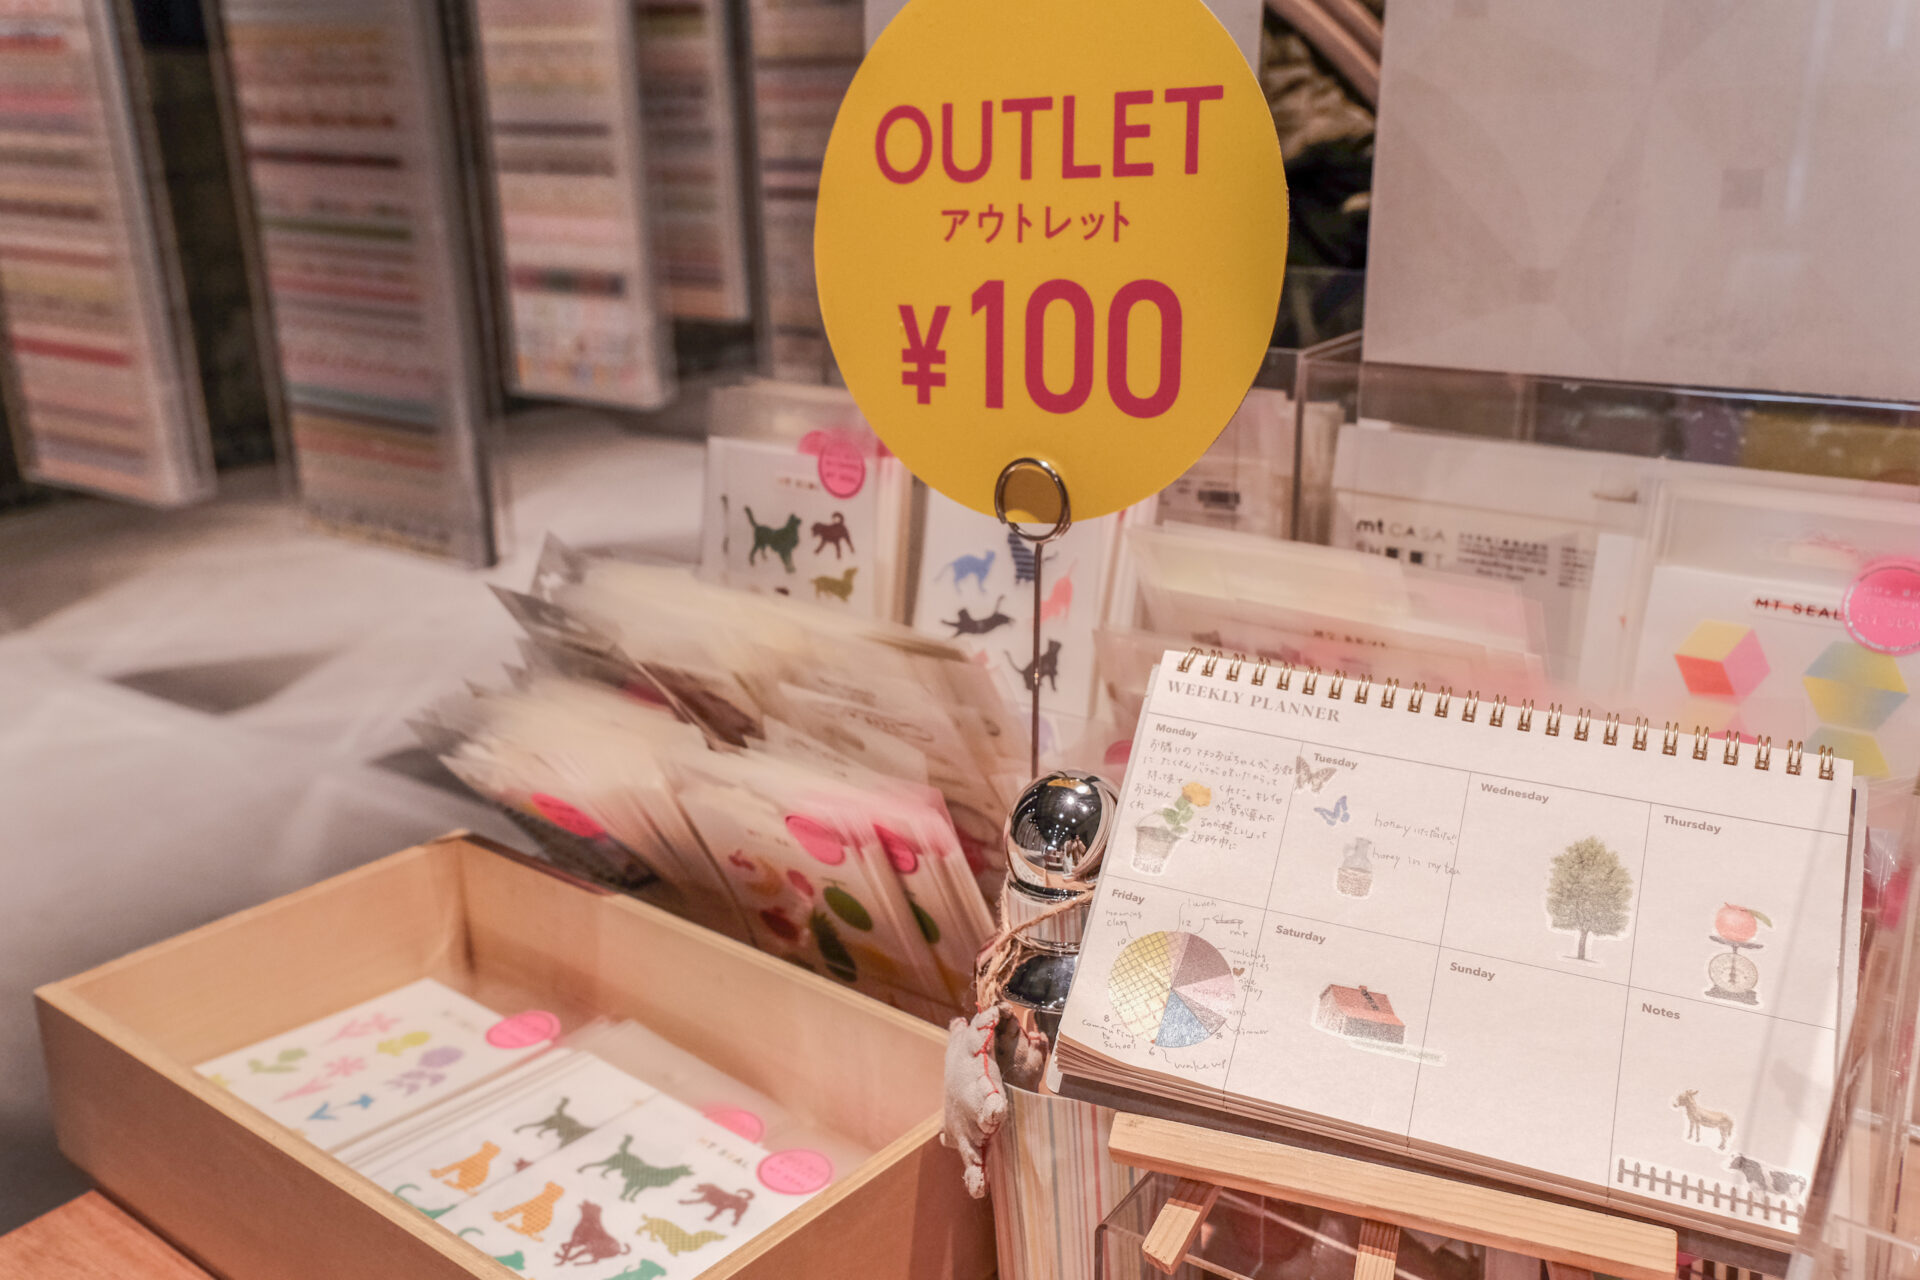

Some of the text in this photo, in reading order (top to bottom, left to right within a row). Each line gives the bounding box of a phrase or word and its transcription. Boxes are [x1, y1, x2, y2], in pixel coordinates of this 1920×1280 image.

[875, 85, 1224, 184] OUTLET
[941, 200, 1130, 243] アウトレット
[898, 279, 1182, 419] ¥100
[1355, 518, 1384, 535] mt
[1755, 598, 1781, 611] MT
[1168, 680, 1341, 723] WEEKLY PLANNER
[1156, 723, 1198, 740] Monday
[1313, 753, 1359, 770] Tuesday
[1480, 782, 1550, 804] Wednesday
[1663, 815, 1722, 835] Thursday
[1428, 861, 1442, 874] my
[1112, 889, 1145, 905] Friday
[1275, 923, 1327, 944] Saturday
[1450, 961, 1496, 982] Sunday
[1103, 1014, 1110, 1023] 8
[1641, 1003, 1681, 1020] Notes
[1148, 1046, 1155, 1057] 6
